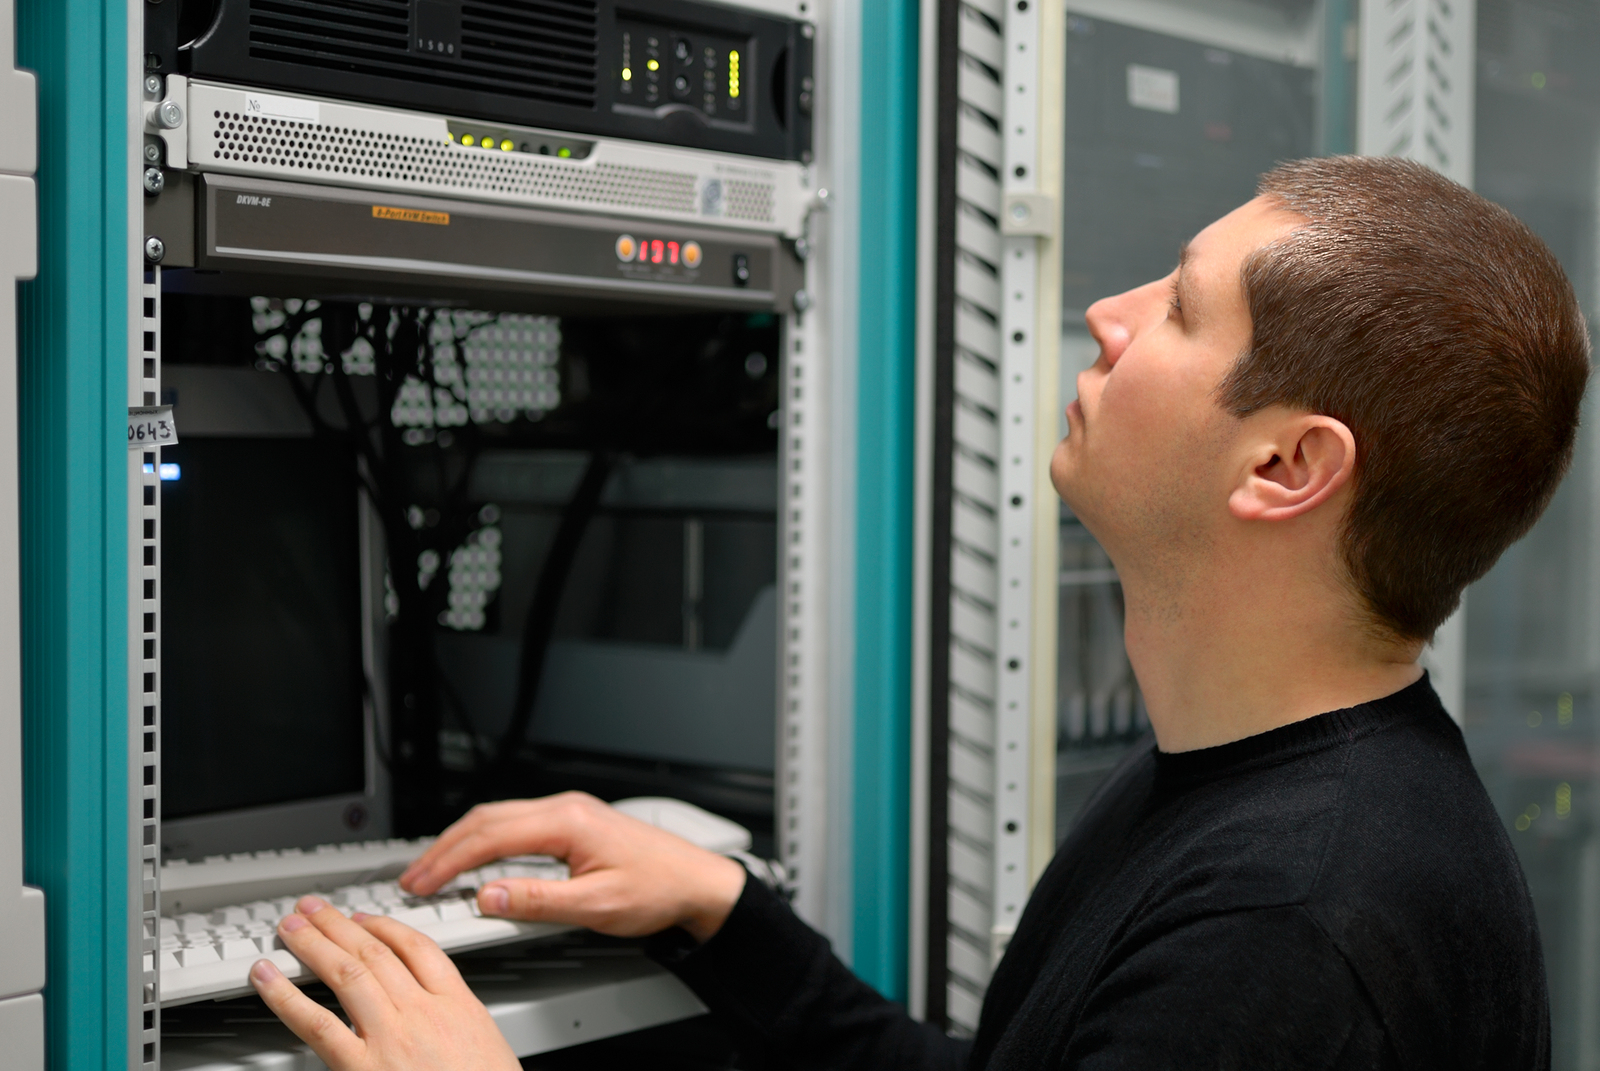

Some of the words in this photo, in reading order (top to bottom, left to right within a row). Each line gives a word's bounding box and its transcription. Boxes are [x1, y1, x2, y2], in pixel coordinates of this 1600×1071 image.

[419, 38, 454, 54] 1500
[236, 194, 271, 207] DKVM-8E
[403, 211, 420, 219] KVM
